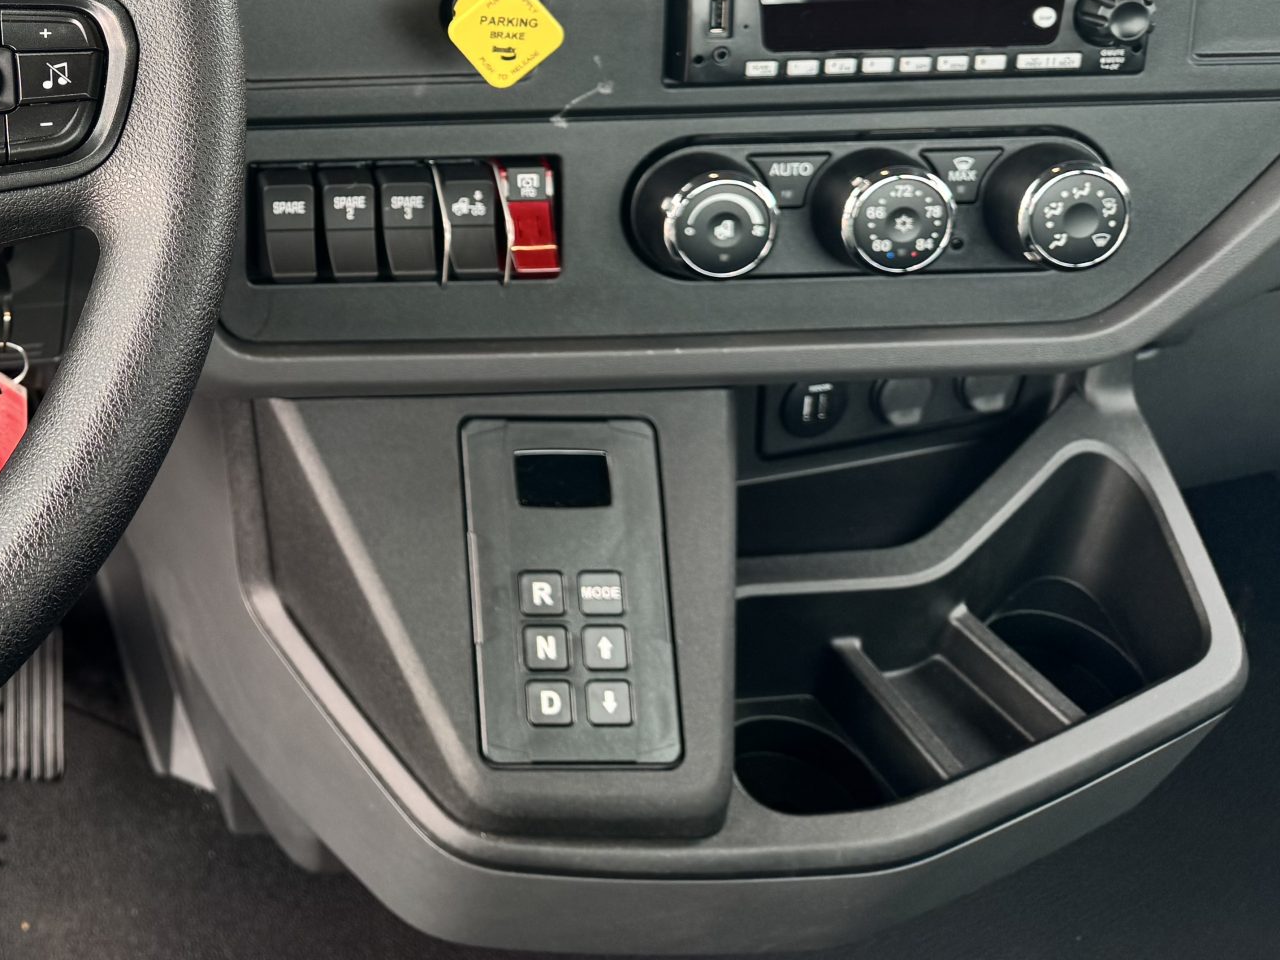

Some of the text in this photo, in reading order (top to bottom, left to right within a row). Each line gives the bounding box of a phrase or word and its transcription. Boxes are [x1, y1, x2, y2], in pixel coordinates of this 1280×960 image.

[480, 16, 539, 28] PARKING
[490, 31, 525, 40] BRAKE
[769, 162, 814, 177] AUTO
[948, 170, 977, 182] MAX
[894, 185, 913, 197] 72
[272, 200, 306, 215] SPARE
[333, 196, 366, 209] SPARE
[390, 195, 424, 209] SPARE
[345, 208, 355, 220] 2
[403, 208, 413, 220] 3
[872, 239, 892, 252] 60
[915, 238, 934, 251] 84
[532, 581, 553, 606] R
[581, 586, 621, 600] MODE
[536, 635, 557, 660] N
[540, 690, 561, 715] D
